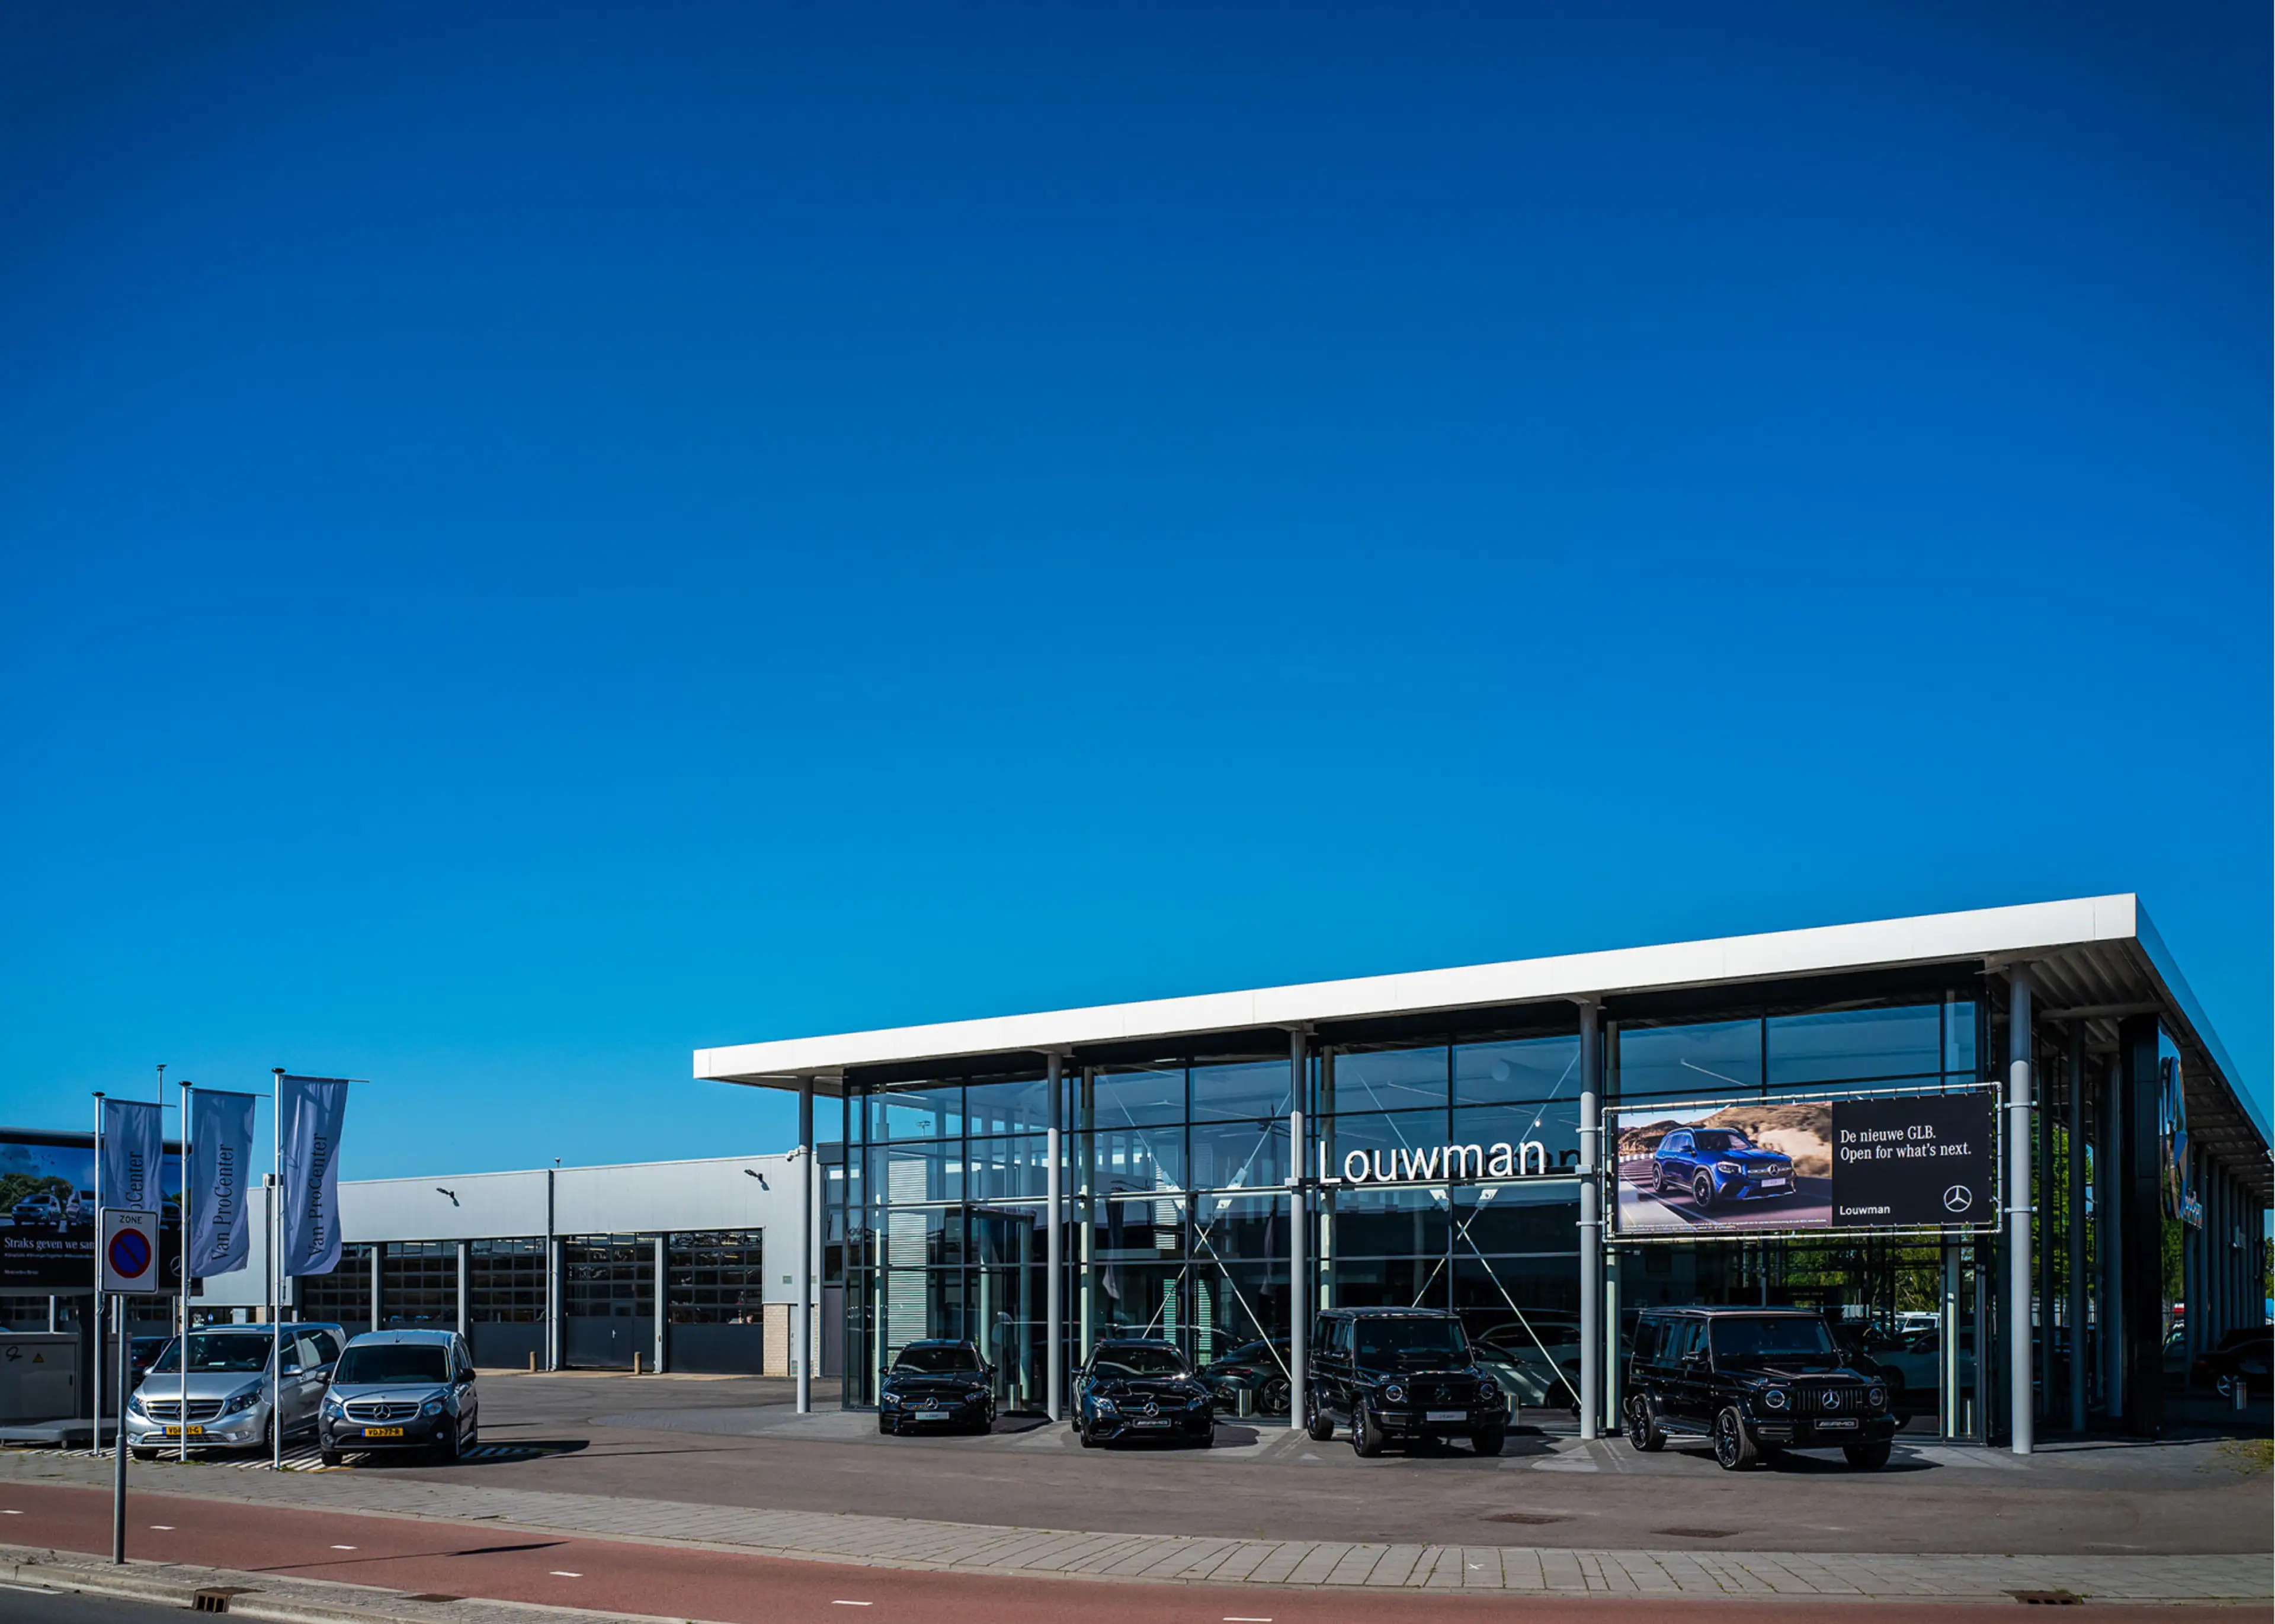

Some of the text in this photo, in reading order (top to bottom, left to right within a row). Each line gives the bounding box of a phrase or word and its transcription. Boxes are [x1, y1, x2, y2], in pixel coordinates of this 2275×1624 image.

[1840, 1125, 1936, 1143] De nieuwe GLB.
[1319, 1140, 1545, 1183] Louwman
[1840, 1142, 1972, 1163] Open for what's next.
[211, 1144, 233, 1261] Van ProCenter
[307, 1132, 327, 1259] Van ProCenter
[120, 1215, 142, 1224] ZONE
[1840, 1206, 1891, 1215] Louwman
[5, 1237, 34, 1249] Straks
[36, 1240, 63, 1251] geven
[65, 1241, 78, 1249] we
